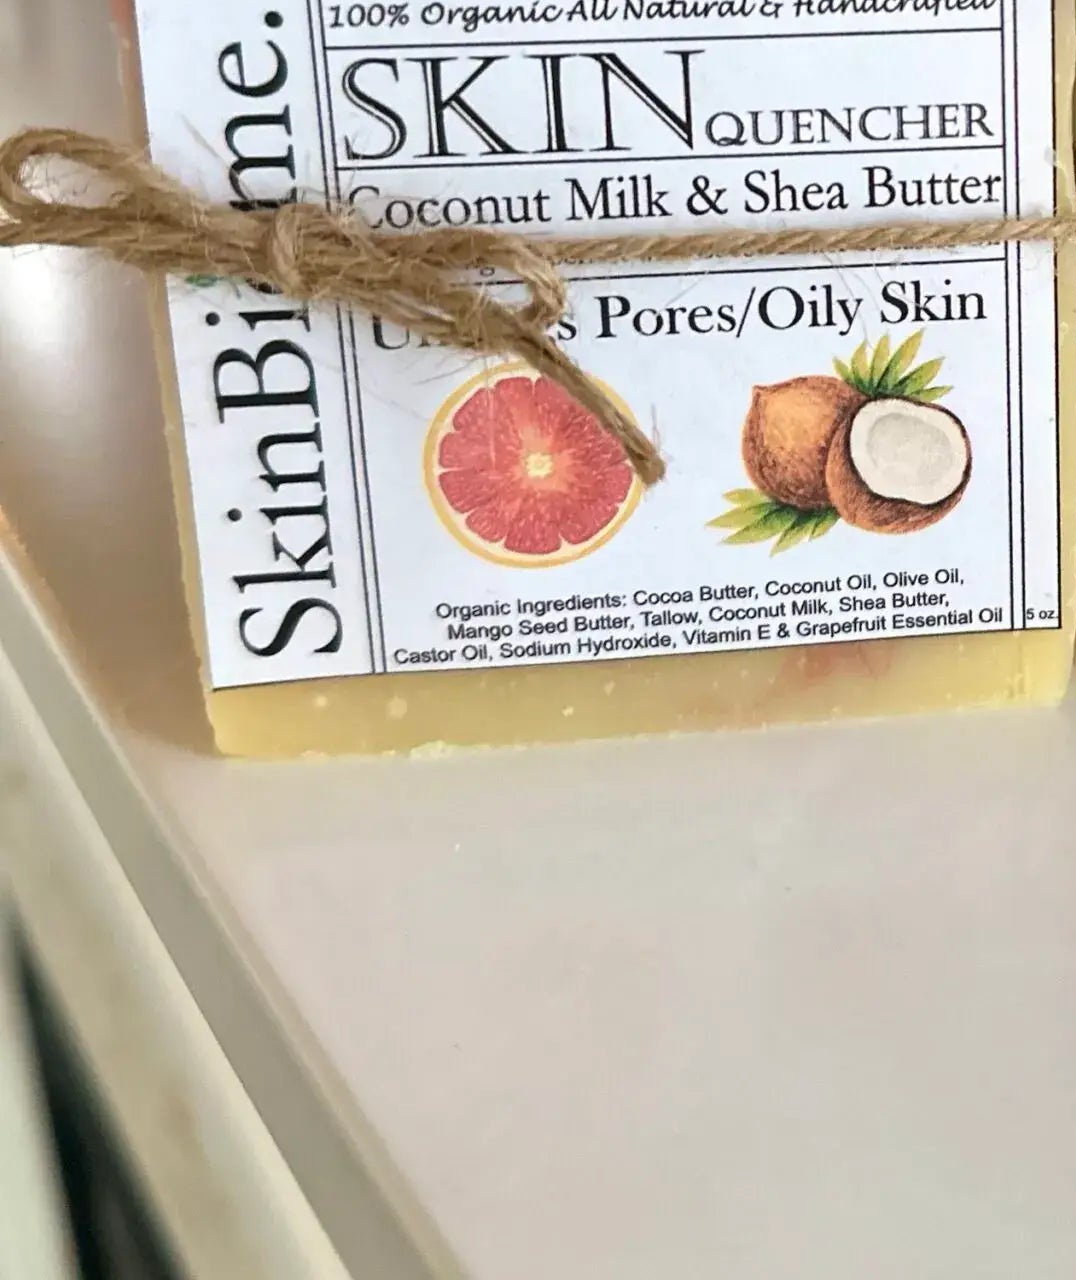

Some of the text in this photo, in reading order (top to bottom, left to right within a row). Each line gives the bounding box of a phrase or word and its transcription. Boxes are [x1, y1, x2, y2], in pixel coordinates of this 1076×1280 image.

[329, 3, 409, 29] 100%
[421, 1, 564, 32] Organic
[342, 50, 994, 160] SKIN QUENCHER
[349, 166, 1001, 229] Coconut Milk & Shea Butter
[205, 9, 343, 658] SkinBime.
[594, 284, 863, 338] Pores/Oily
[880, 279, 987, 324] Skin
[436, 568, 964, 621] Organic Ingredients: Cocoa Butter, Coconut Oil, Olive Oil,
[448, 591, 949, 642] Mango Seed Butter, Tallow, Coconut Milk, Shea Butter,
[1026, 607, 1035, 620] 5
[394, 606, 1002, 664] Castor Oil, Sodium Hydroxide, Vitamin E & Grapefruit Essential Oil
